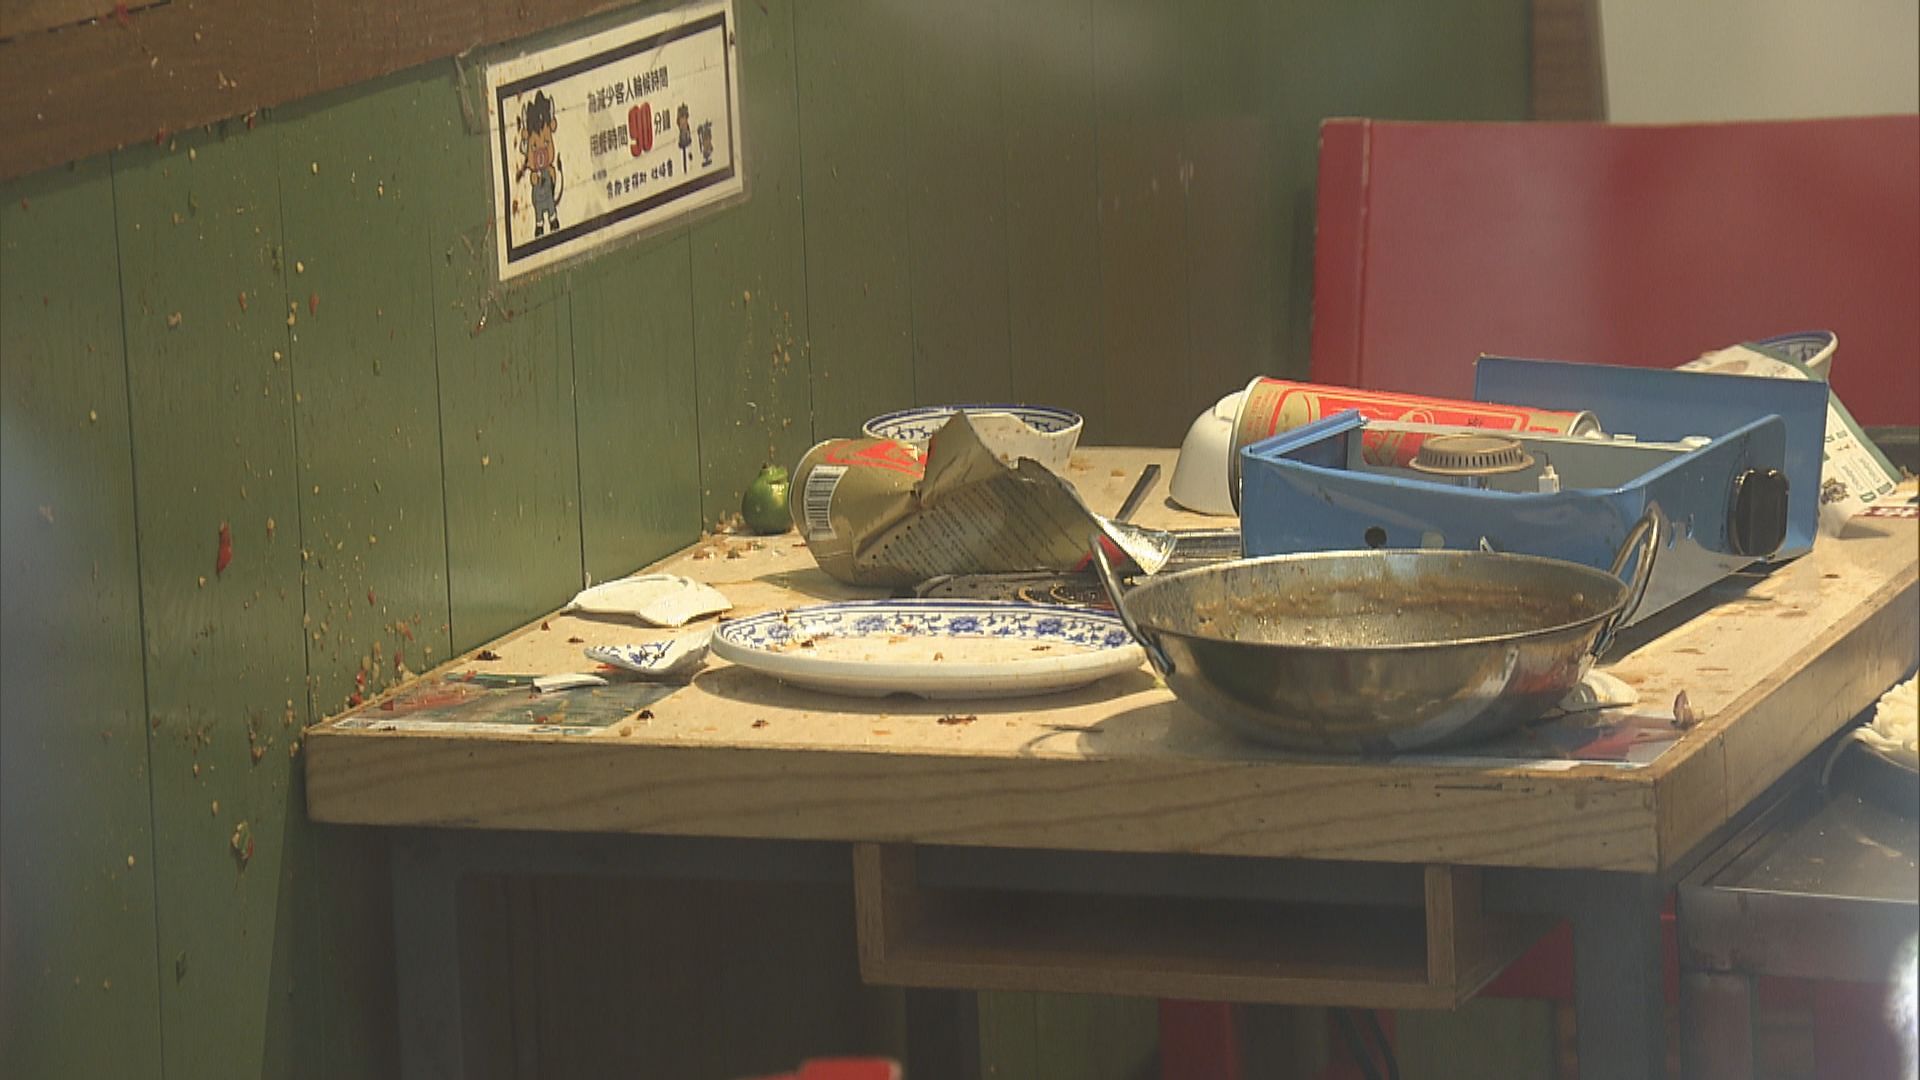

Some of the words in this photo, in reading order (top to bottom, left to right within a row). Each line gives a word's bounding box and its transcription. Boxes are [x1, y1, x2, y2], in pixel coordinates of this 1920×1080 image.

[587, 65, 669, 114] 為減少客人輪候時間
